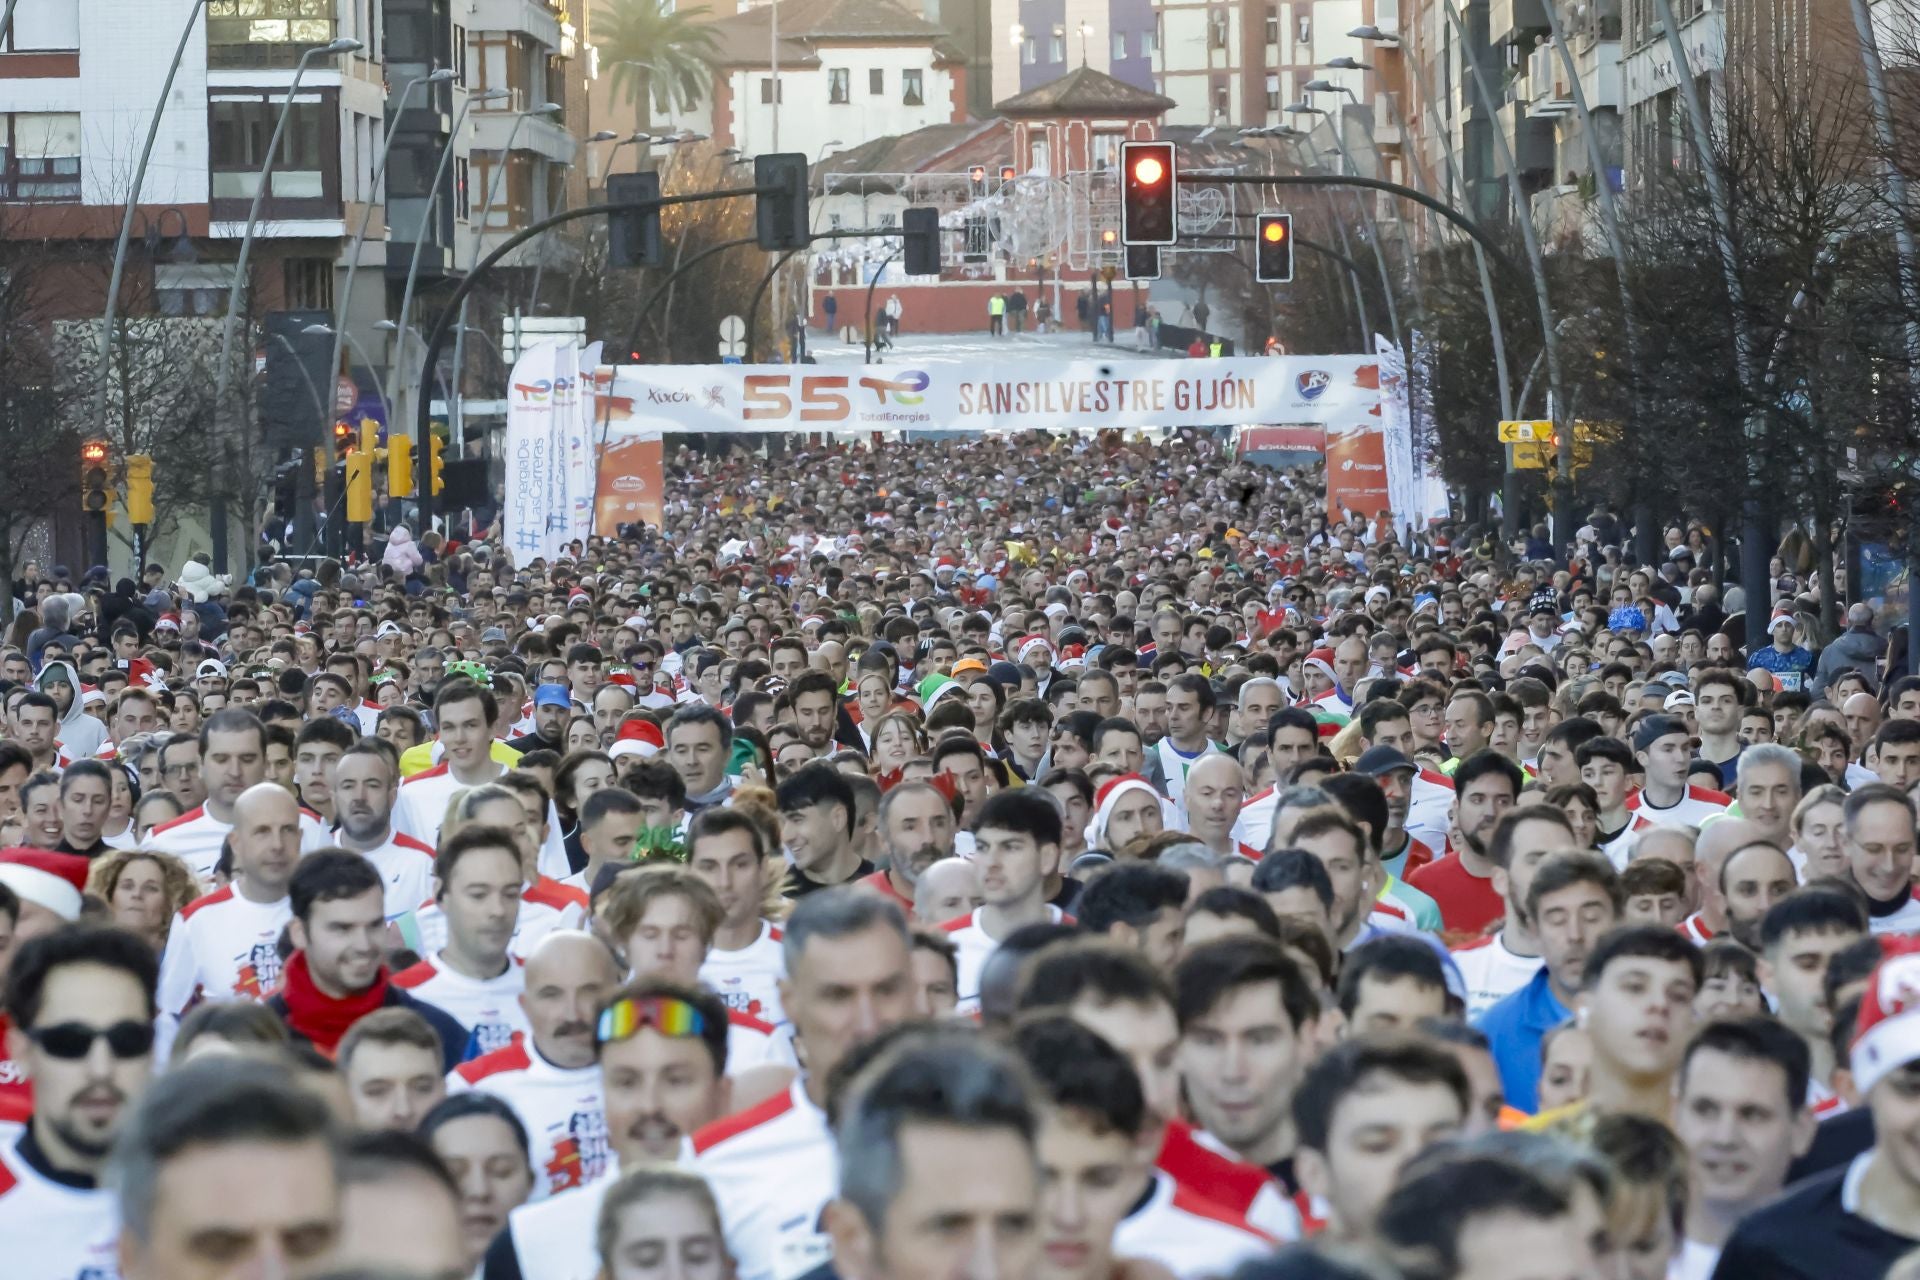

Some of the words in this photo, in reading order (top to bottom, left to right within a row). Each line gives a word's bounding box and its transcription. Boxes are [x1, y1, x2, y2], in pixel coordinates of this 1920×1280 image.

[743, 375, 850, 421] 55
[958, 380, 1165, 415] SANSILVESTRE
[1174, 371, 1255, 411] GIJÓN
[859, 412, 930, 423] TotalEnergies
